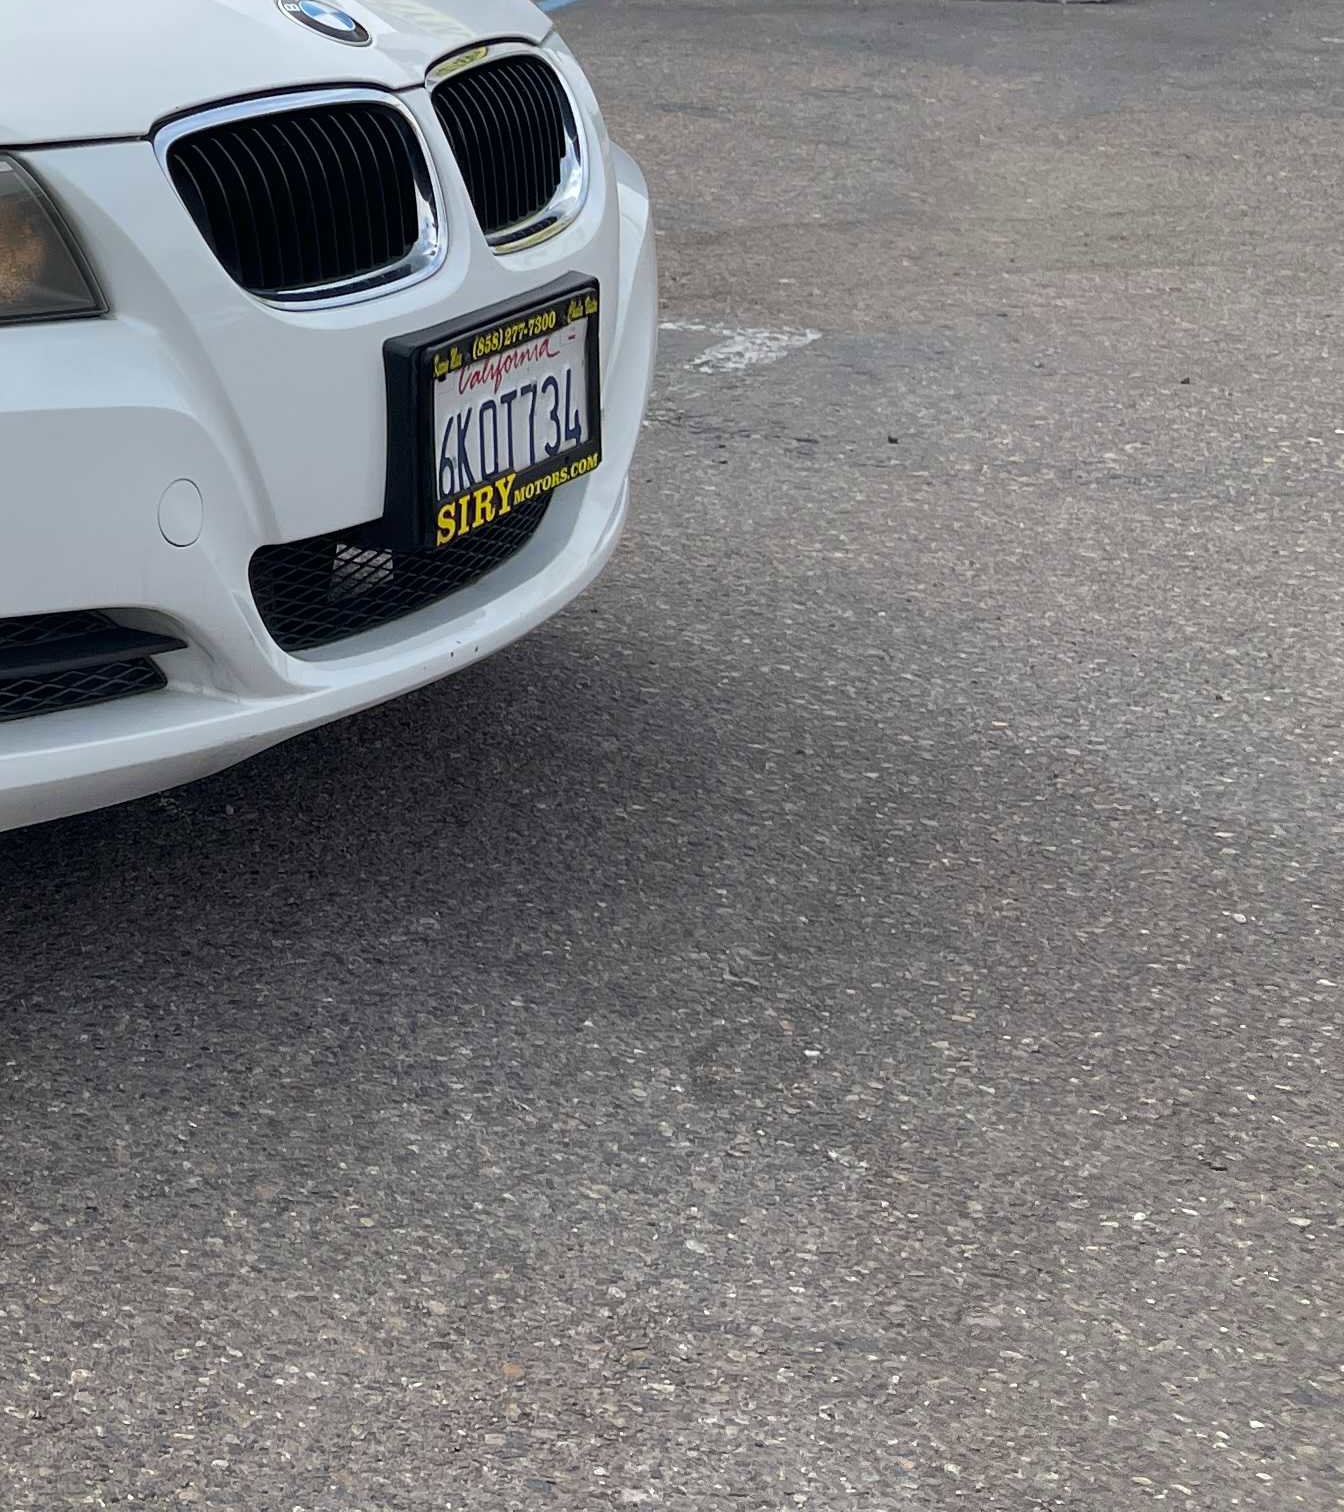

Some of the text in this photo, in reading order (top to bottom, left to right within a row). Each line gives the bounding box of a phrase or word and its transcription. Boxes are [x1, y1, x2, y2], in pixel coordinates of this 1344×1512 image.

[457, 338, 560, 395] California
[438, 368, 582, 500] 6KOT734
[436, 452, 599, 547] SIRY MOTORS.COM
